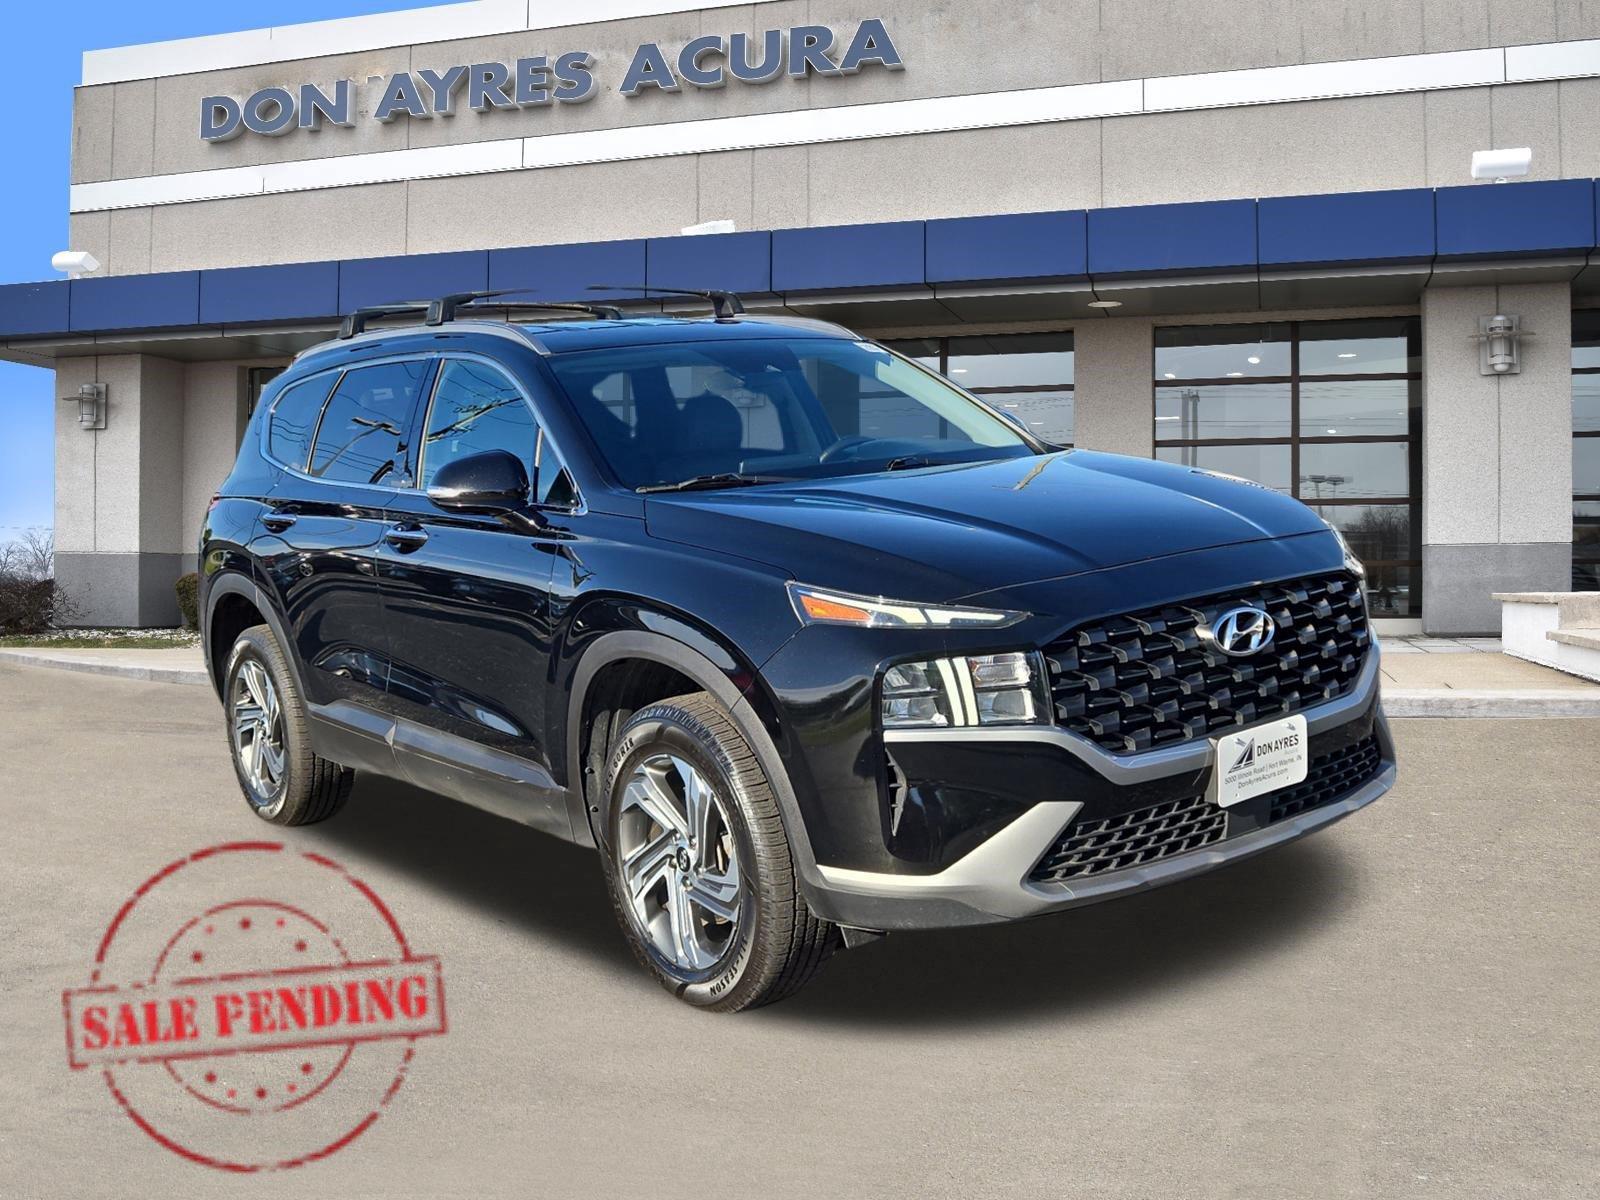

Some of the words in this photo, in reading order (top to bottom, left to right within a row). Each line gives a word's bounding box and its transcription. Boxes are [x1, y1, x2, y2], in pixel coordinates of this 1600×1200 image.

[199, 79, 354, 143] DON
[374, 52, 596, 122] AYRES
[619, 18, 904, 97] ACURA
